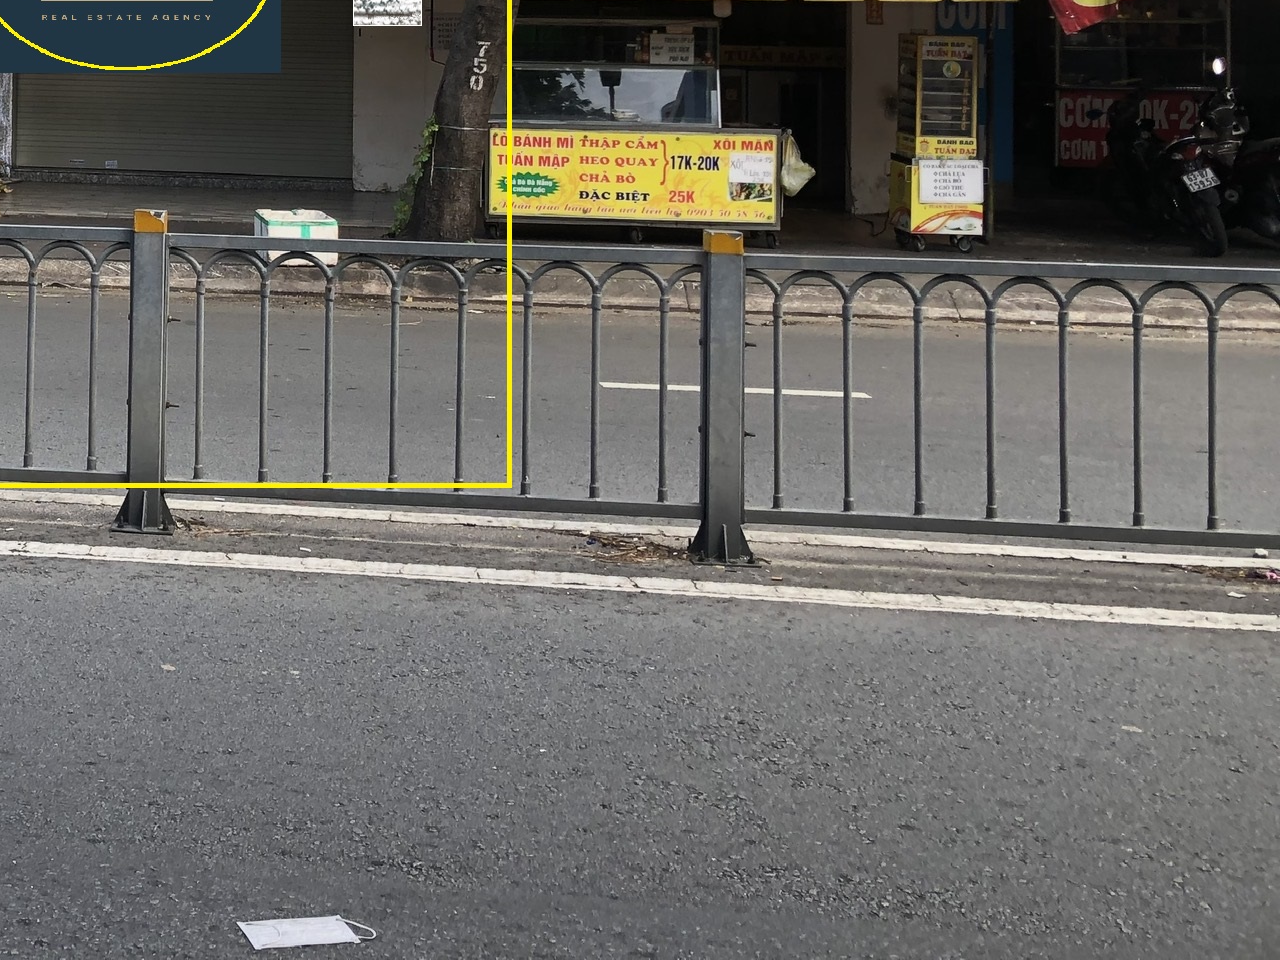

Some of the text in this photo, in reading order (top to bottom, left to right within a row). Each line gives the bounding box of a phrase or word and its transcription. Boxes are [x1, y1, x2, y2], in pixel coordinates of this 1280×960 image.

[513, 134, 552, 148] BÁNH
[557, 135, 574, 149] MÌ
[580, 138, 621, 151] THẬP
[713, 138, 736, 151] XÔI
[539, 153, 570, 170] MẬP
[579, 156, 659, 168] HEO QUAY
[671, 155, 720, 171] 17K-20K
[579, 170, 636, 184] CHẢ BÒ
[579, 188, 650, 204] ĐẶC BIỆT
[668, 190, 695, 203] 25K
